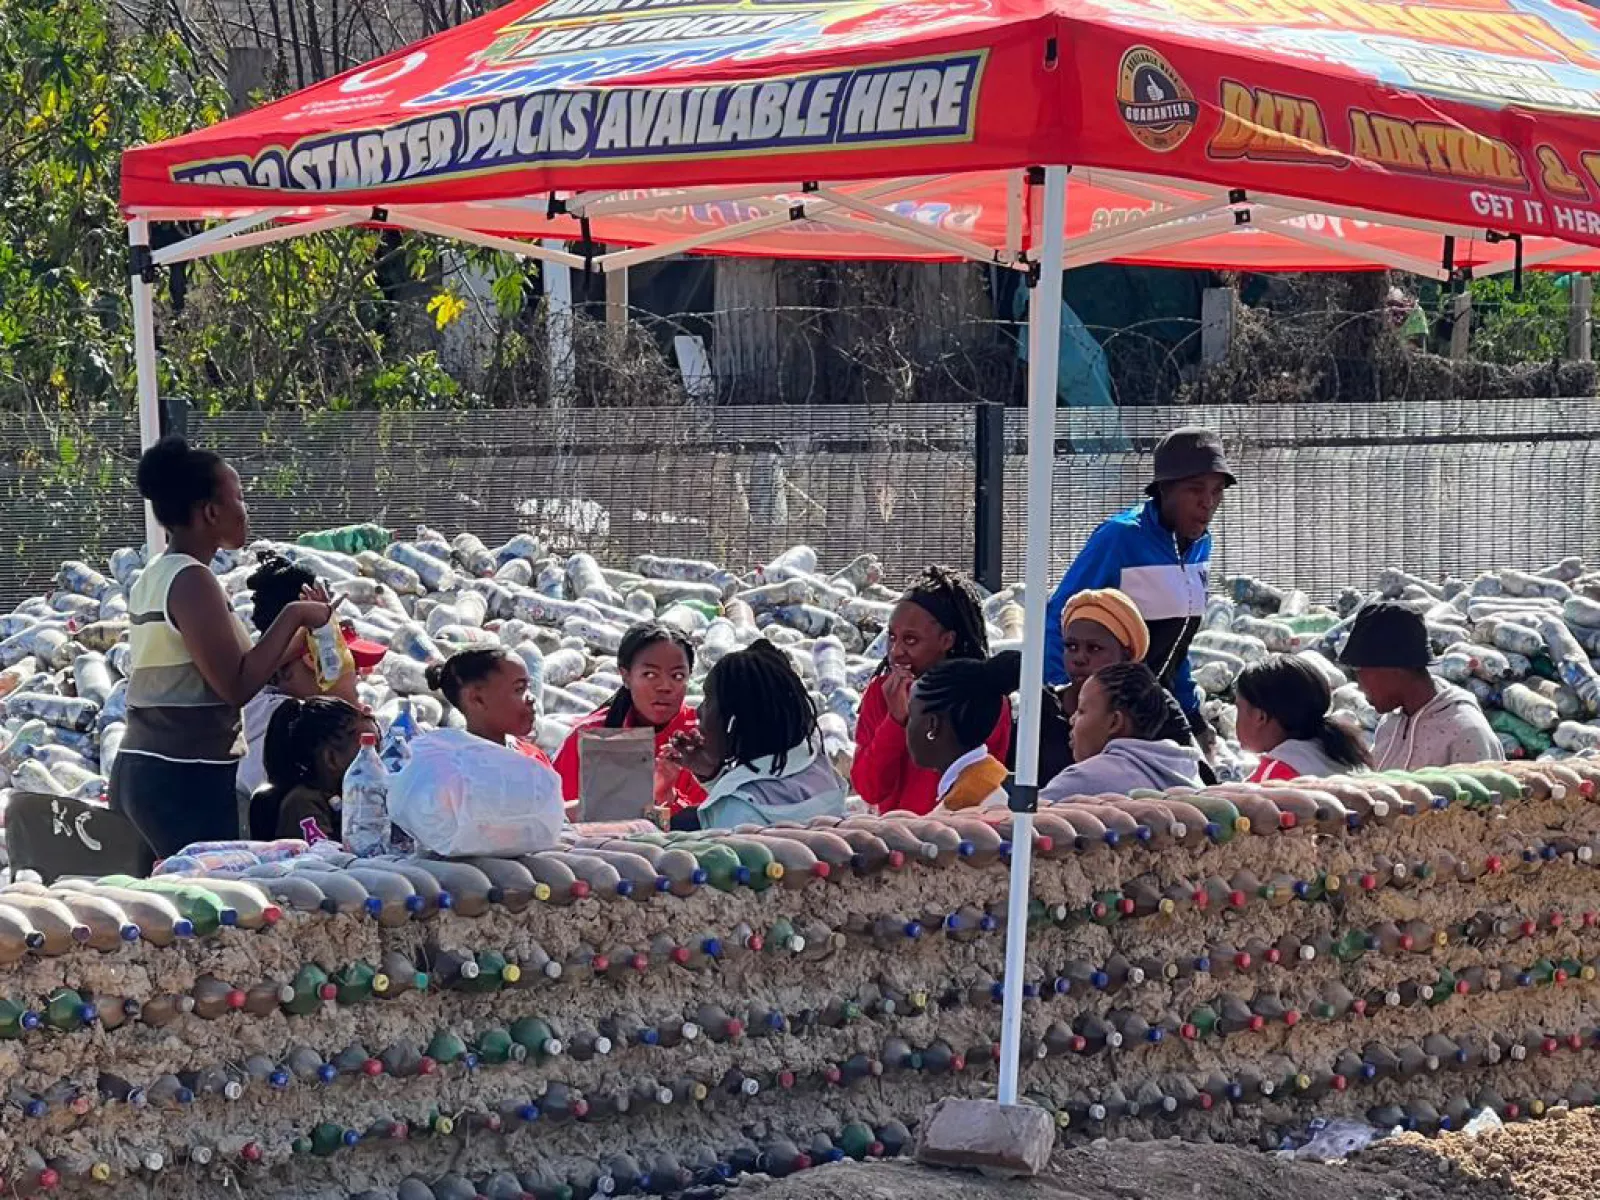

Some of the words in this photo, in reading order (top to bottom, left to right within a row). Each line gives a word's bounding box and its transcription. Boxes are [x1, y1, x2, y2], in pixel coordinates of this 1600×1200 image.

[513, 12, 806, 57] ELECTRICITY
[289, 111, 458, 190] STARTER
[458, 91, 592, 163] PACKS
[595, 77, 843, 150] AVAILABLE
[844, 64, 971, 135] HERE
[1208, 80, 1336, 158] DATA
[1470, 190, 1514, 220] GET
[1523, 199, 1543, 225] IT
